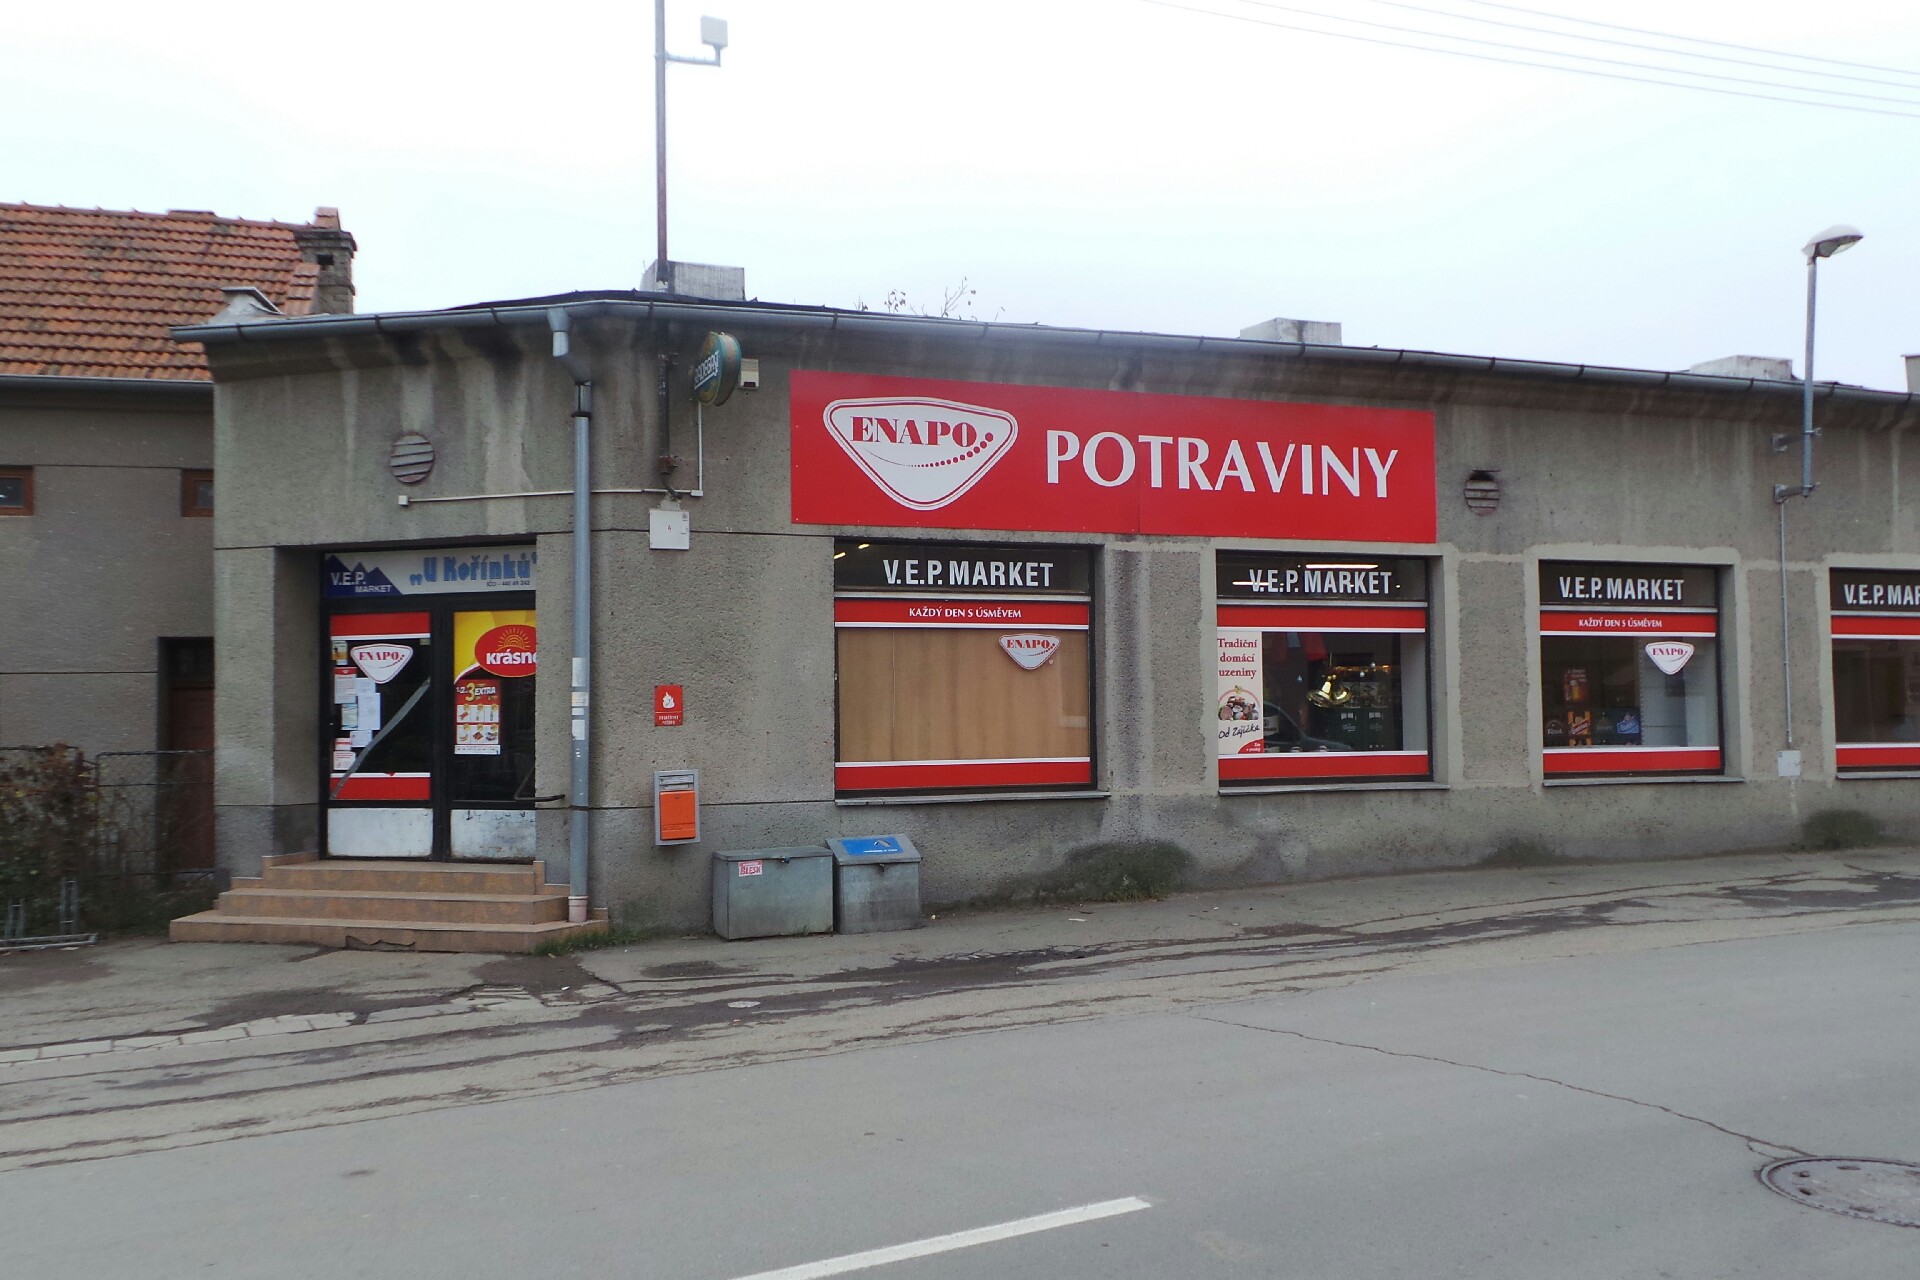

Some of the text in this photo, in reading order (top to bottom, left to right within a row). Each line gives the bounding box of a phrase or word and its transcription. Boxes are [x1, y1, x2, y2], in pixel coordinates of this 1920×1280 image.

[849, 414, 979, 448] ENAPO
[1046, 429, 1399, 498] POTRAVINY
[330, 571, 367, 586] V.E.P.
[883, 559, 1055, 588] V.E.P. MARKET
[1249, 569, 1393, 594] V.E.P. MARKET
[355, 585, 392, 593] MARKET
[1559, 576, 1685, 601] V.E.P. MARKET
[1844, 584, 1885, 606] V.E.P.
[909, 605, 1022, 619] KAŽDÝ DEN S ÚSMĚVEM
[1578, 617, 1663, 629] KAŽDÝ DEN S ÚSMĚVEM
[1006, 638, 1052, 649] ENAPO
[1217, 638, 1258, 648] Tradiční
[358, 651, 400, 661] ENAPO
[1219, 652, 1255, 663] domácí
[1652, 647, 1685, 657] ENAPO
[1218, 668, 1257, 680] uzeniny
[740, 865, 762, 875] BLESK
